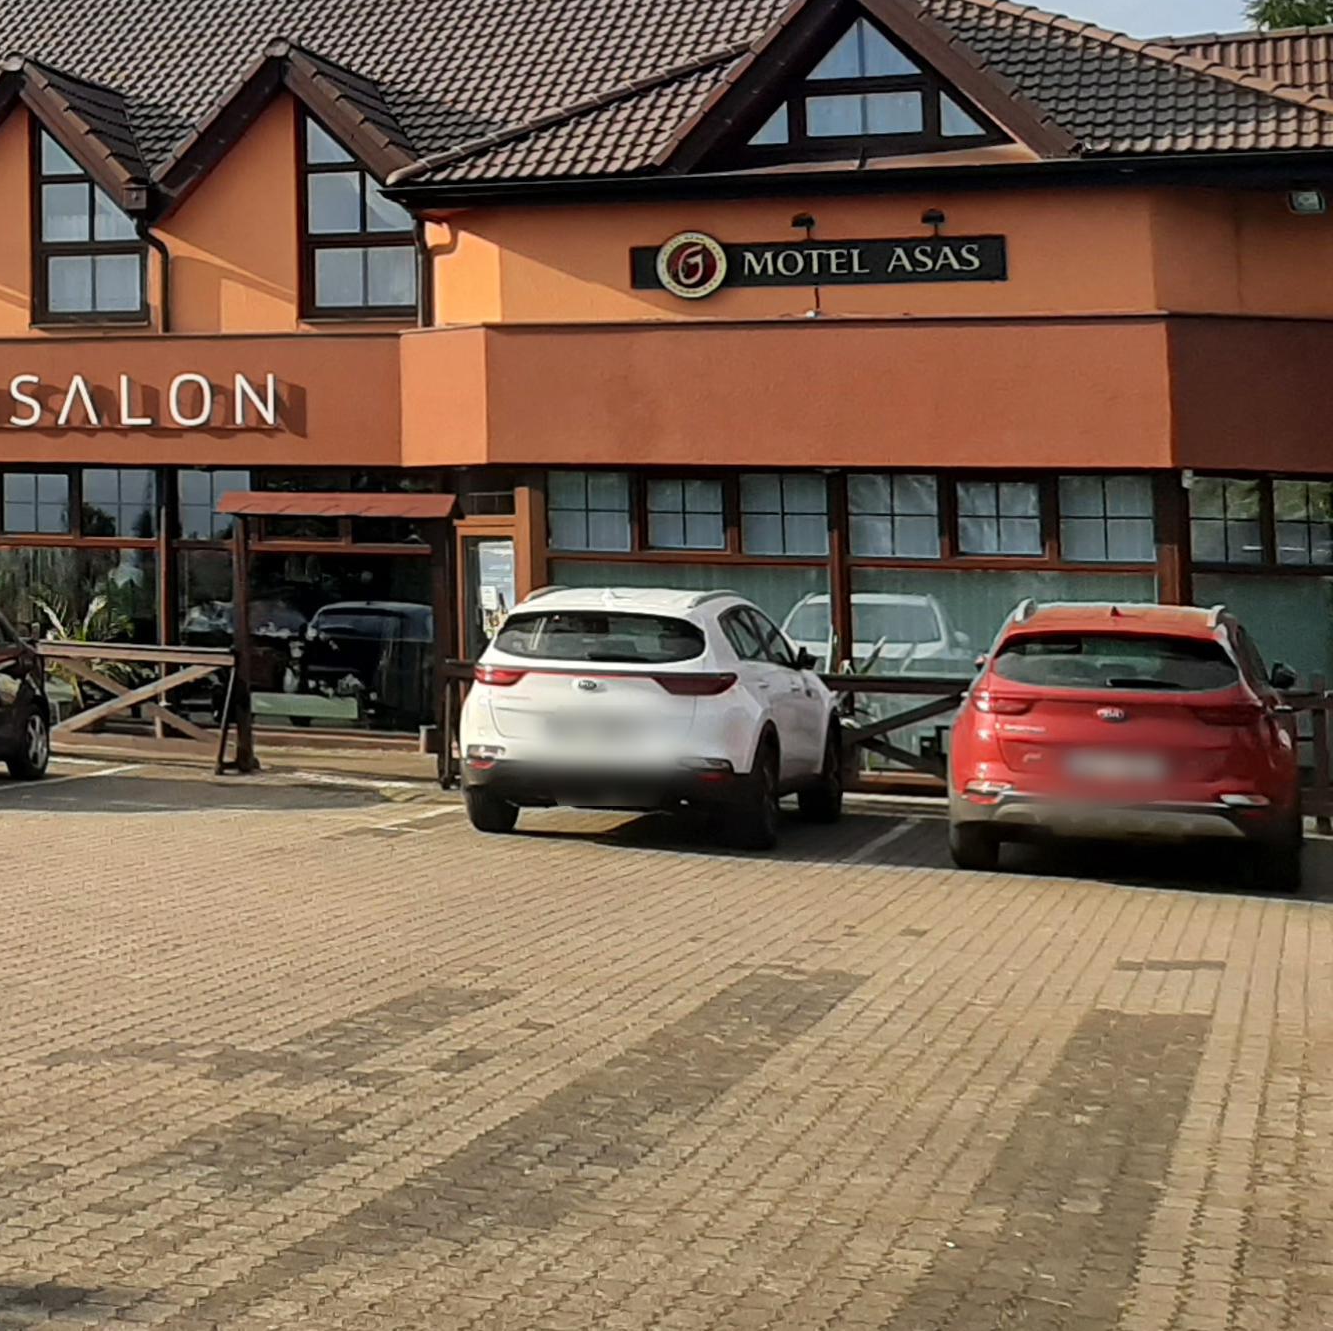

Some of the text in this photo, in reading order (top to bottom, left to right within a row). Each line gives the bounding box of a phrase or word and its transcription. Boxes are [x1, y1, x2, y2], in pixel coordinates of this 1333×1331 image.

[742, 242, 982, 277] MOTEL ASAS
[8, 372, 276, 427] SALON
